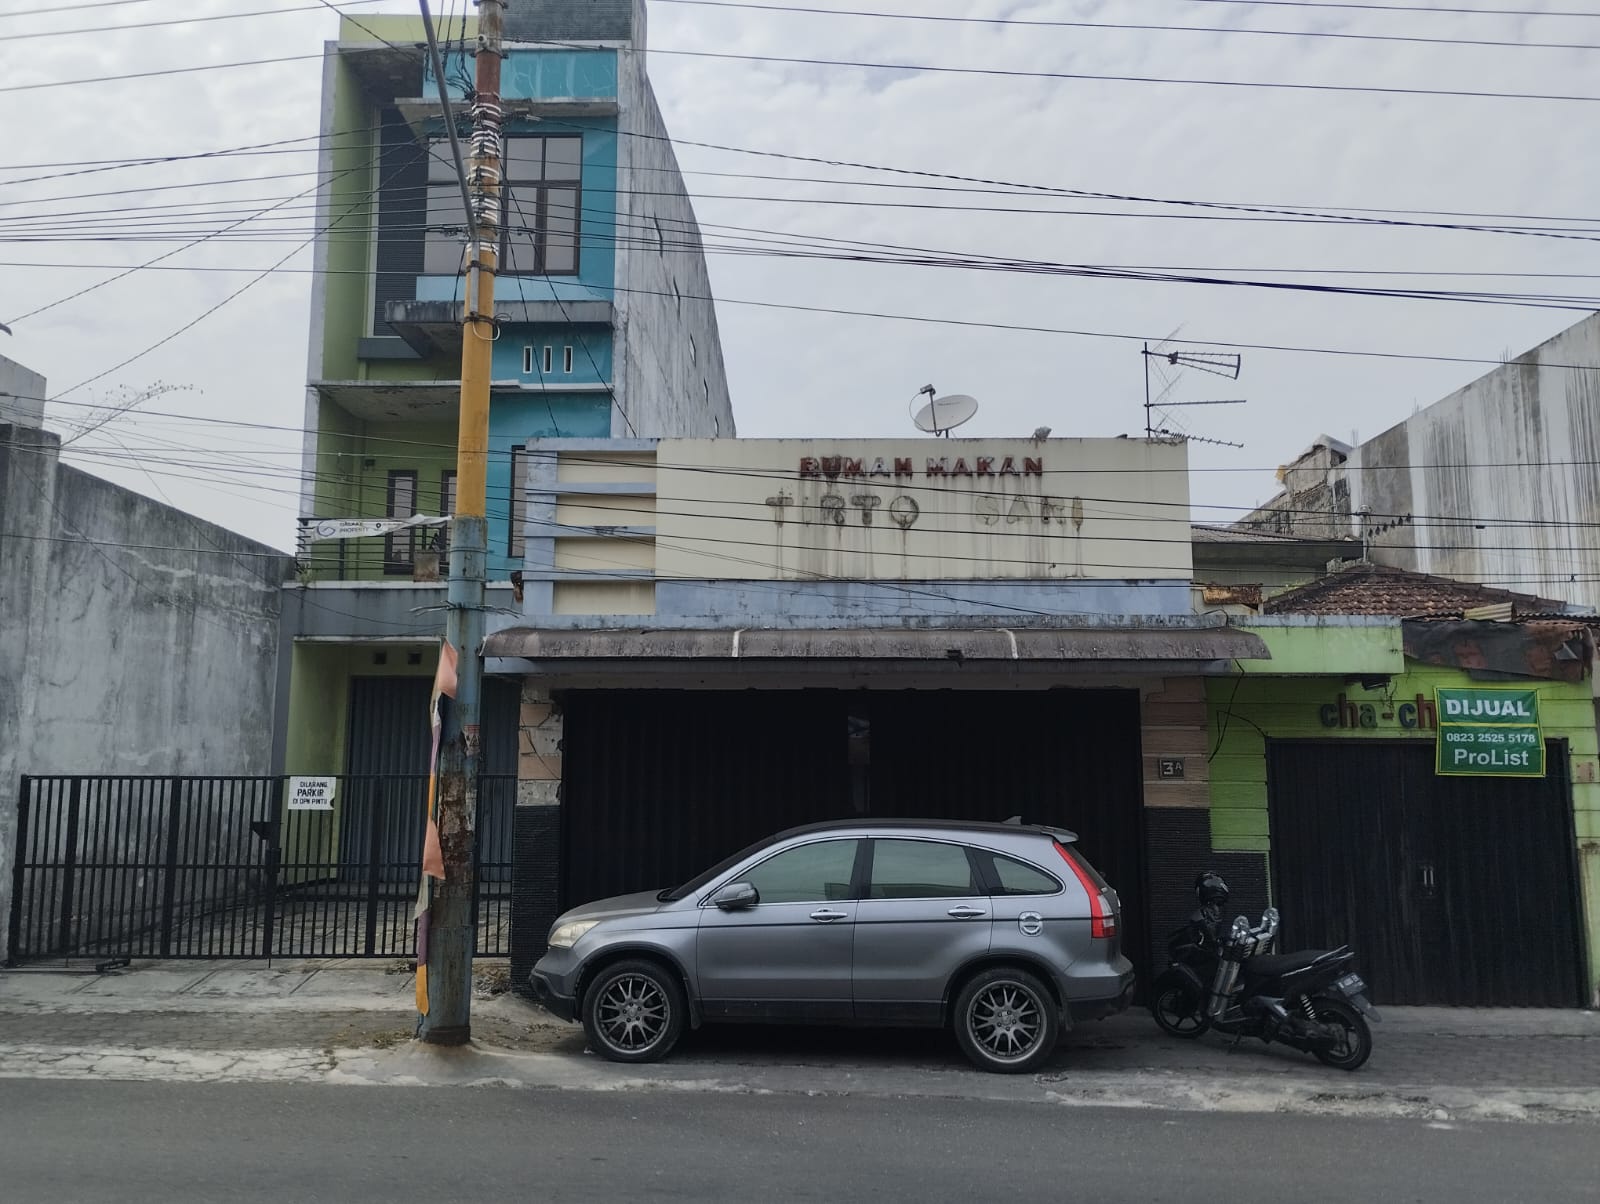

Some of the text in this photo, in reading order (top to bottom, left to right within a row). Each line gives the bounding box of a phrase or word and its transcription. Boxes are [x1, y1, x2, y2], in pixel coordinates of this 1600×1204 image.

[800, 456, 1043, 478] RUMAH MAKAN
[1320, 693, 1438, 728] cha-ch
[1446, 699, 1530, 716] DIJUAL
[1446, 733, 1536, 743] 0823 2525 5178
[1454, 749, 1529, 766] ProList
[297, 789, 324, 797] PARKIR
